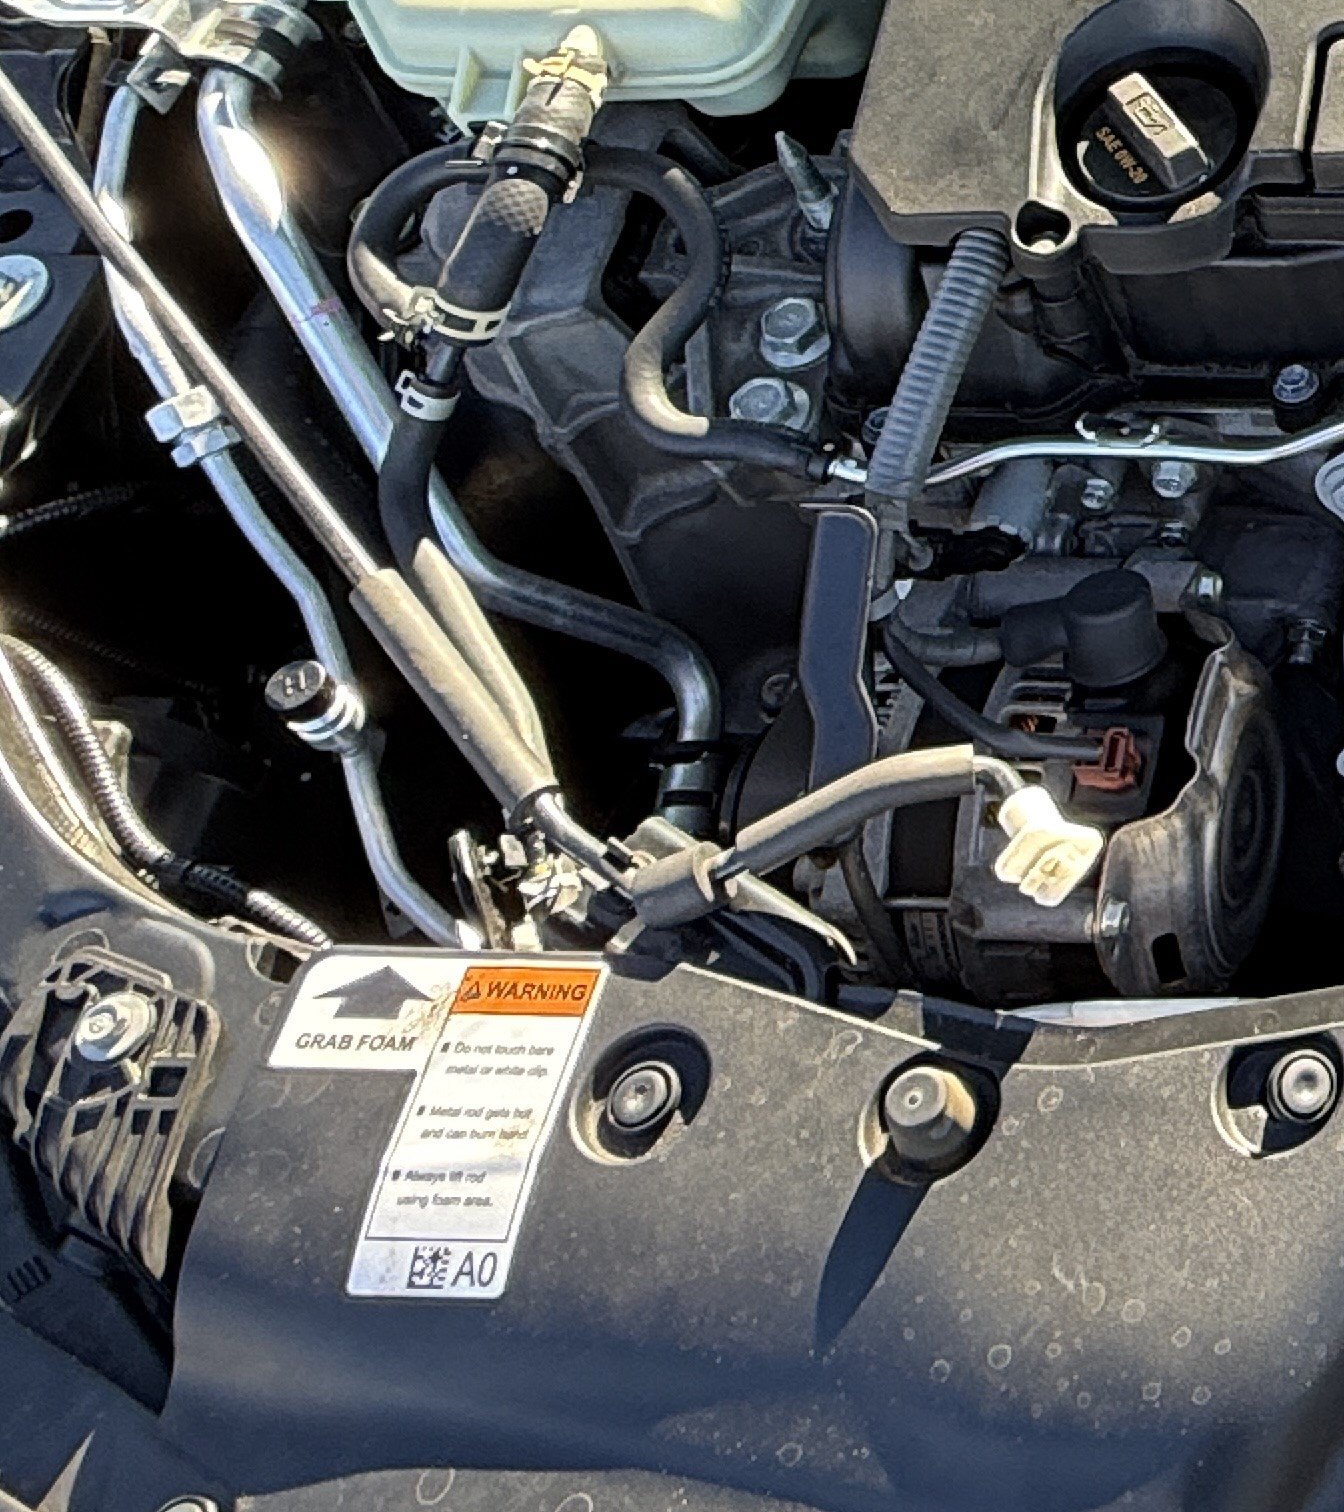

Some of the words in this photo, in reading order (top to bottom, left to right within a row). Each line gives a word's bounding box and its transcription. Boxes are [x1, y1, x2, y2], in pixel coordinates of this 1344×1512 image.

[1095, 126, 1123, 153] SAE
[486, 981, 588, 1001] WARNING
[296, 1033, 353, 1051] GRAB
[355, 1034, 418, 1052] FOAM
[454, 1041, 471, 1053] Do
[474, 1043, 493, 1055] not
[495, 1043, 526, 1055] touch
[528, 1044, 555, 1055] bare
[445, 1064, 478, 1075] metal
[480, 1066, 493, 1075] or
[429, 1105, 463, 1117] Metal
[463, 1106, 484, 1118] rod
[420, 1127, 445, 1139] and
[404, 1170, 446, 1185] Always
[465, 1170, 487, 1183] rod
[396, 1194, 429, 1209] using
[432, 1193, 461, 1206] foam
[451, 1250, 498, 1288] A0
